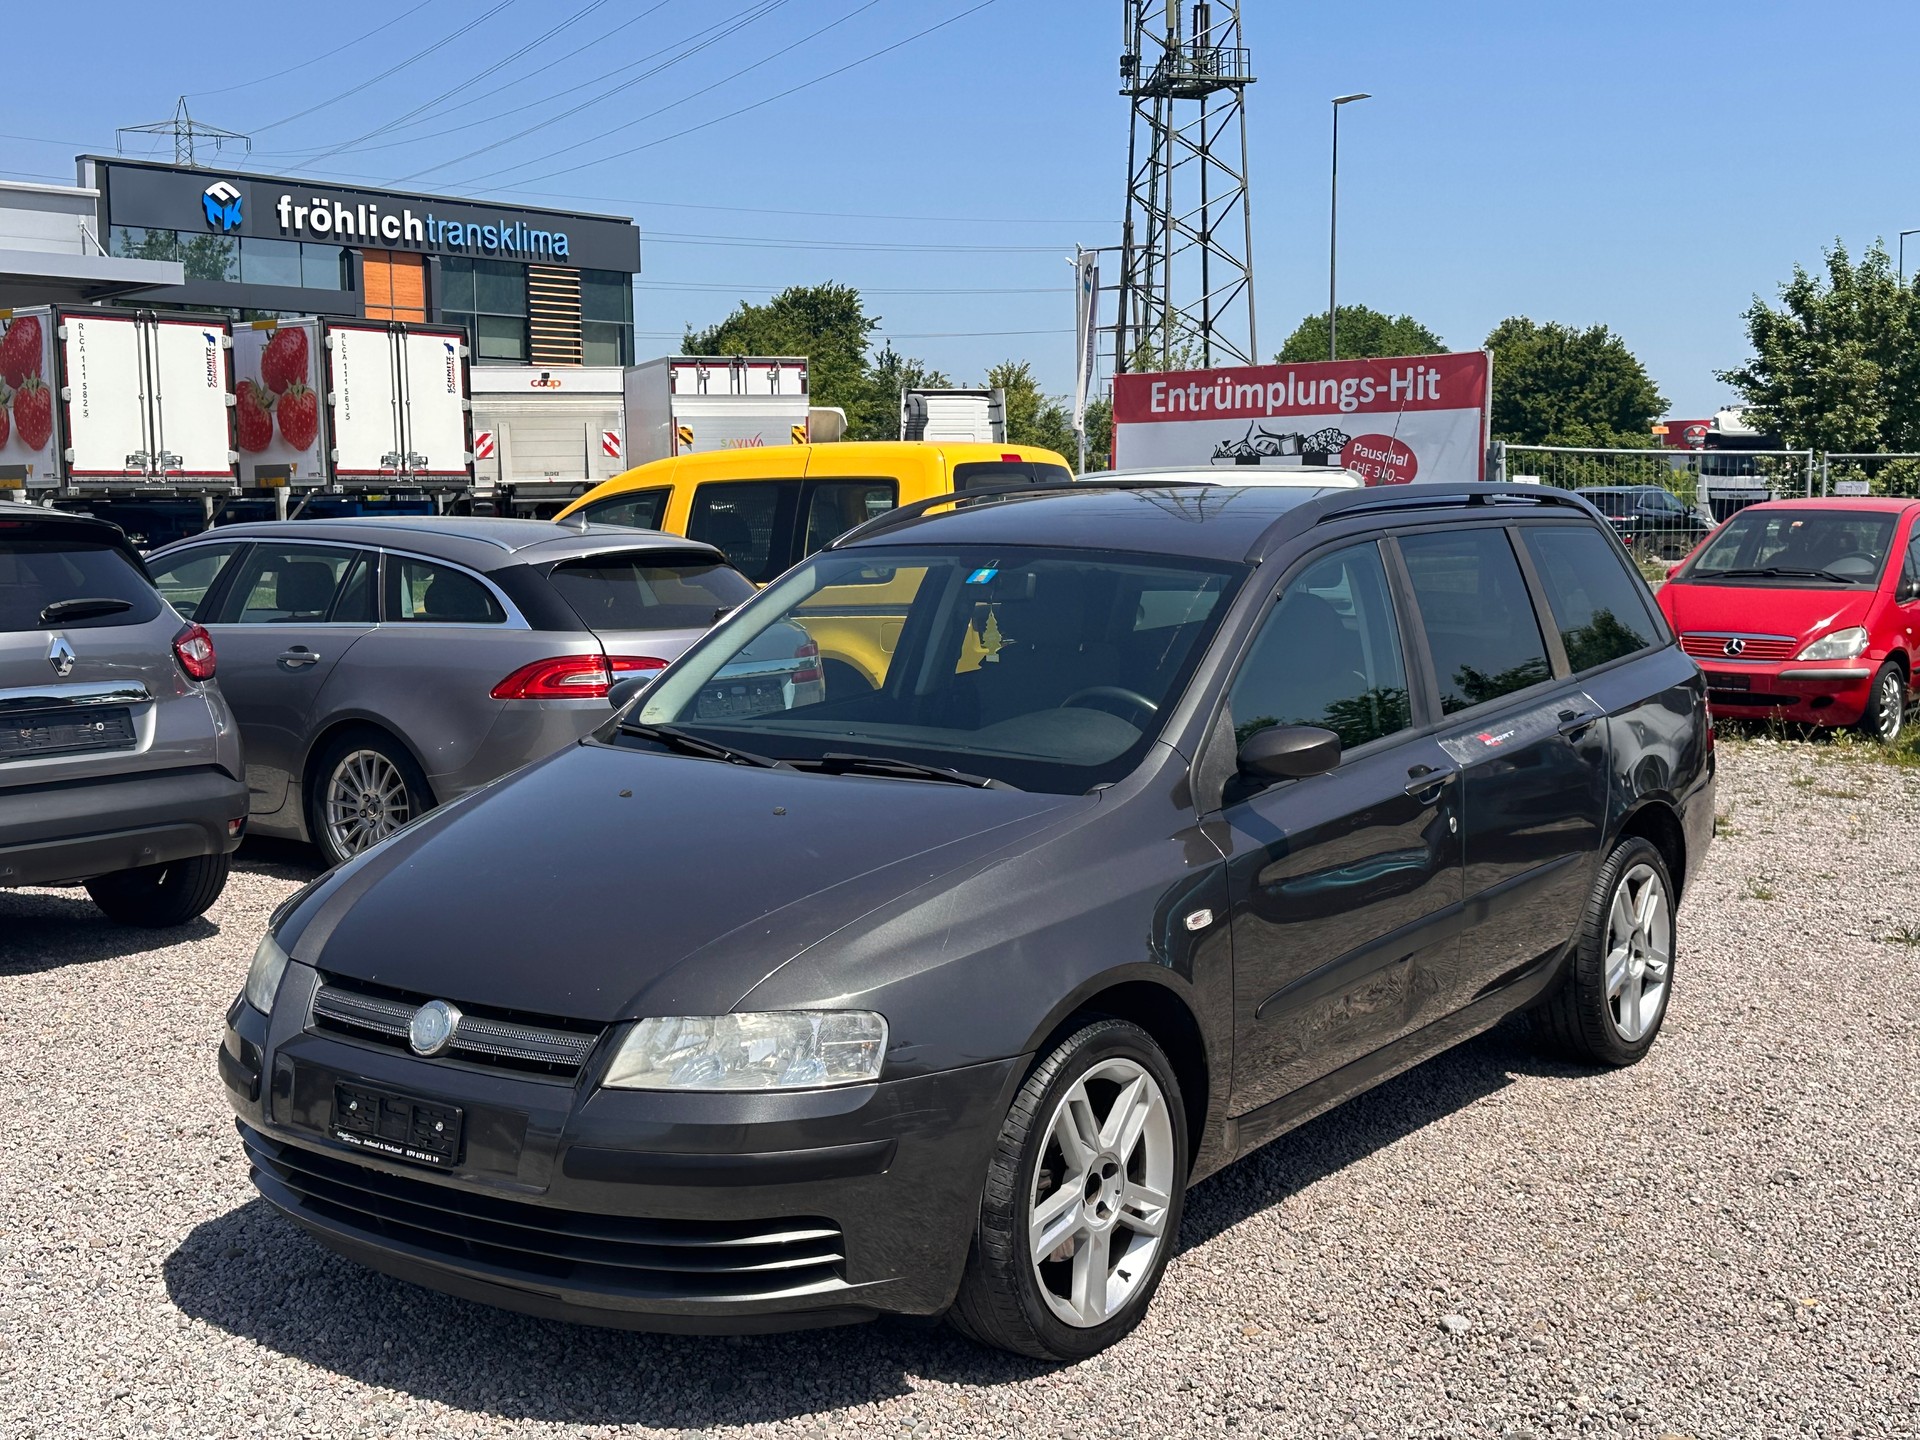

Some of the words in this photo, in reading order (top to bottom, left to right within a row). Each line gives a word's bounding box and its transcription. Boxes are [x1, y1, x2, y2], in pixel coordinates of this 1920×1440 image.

[530, 379, 562, 389] coop
[1150, 365, 1441, 415] Entrümplungs-Hit
[720, 432, 764, 448] SAVIVA
[1352, 442, 1409, 467] Pauschal
[1349, 460, 1372, 475] CHF
